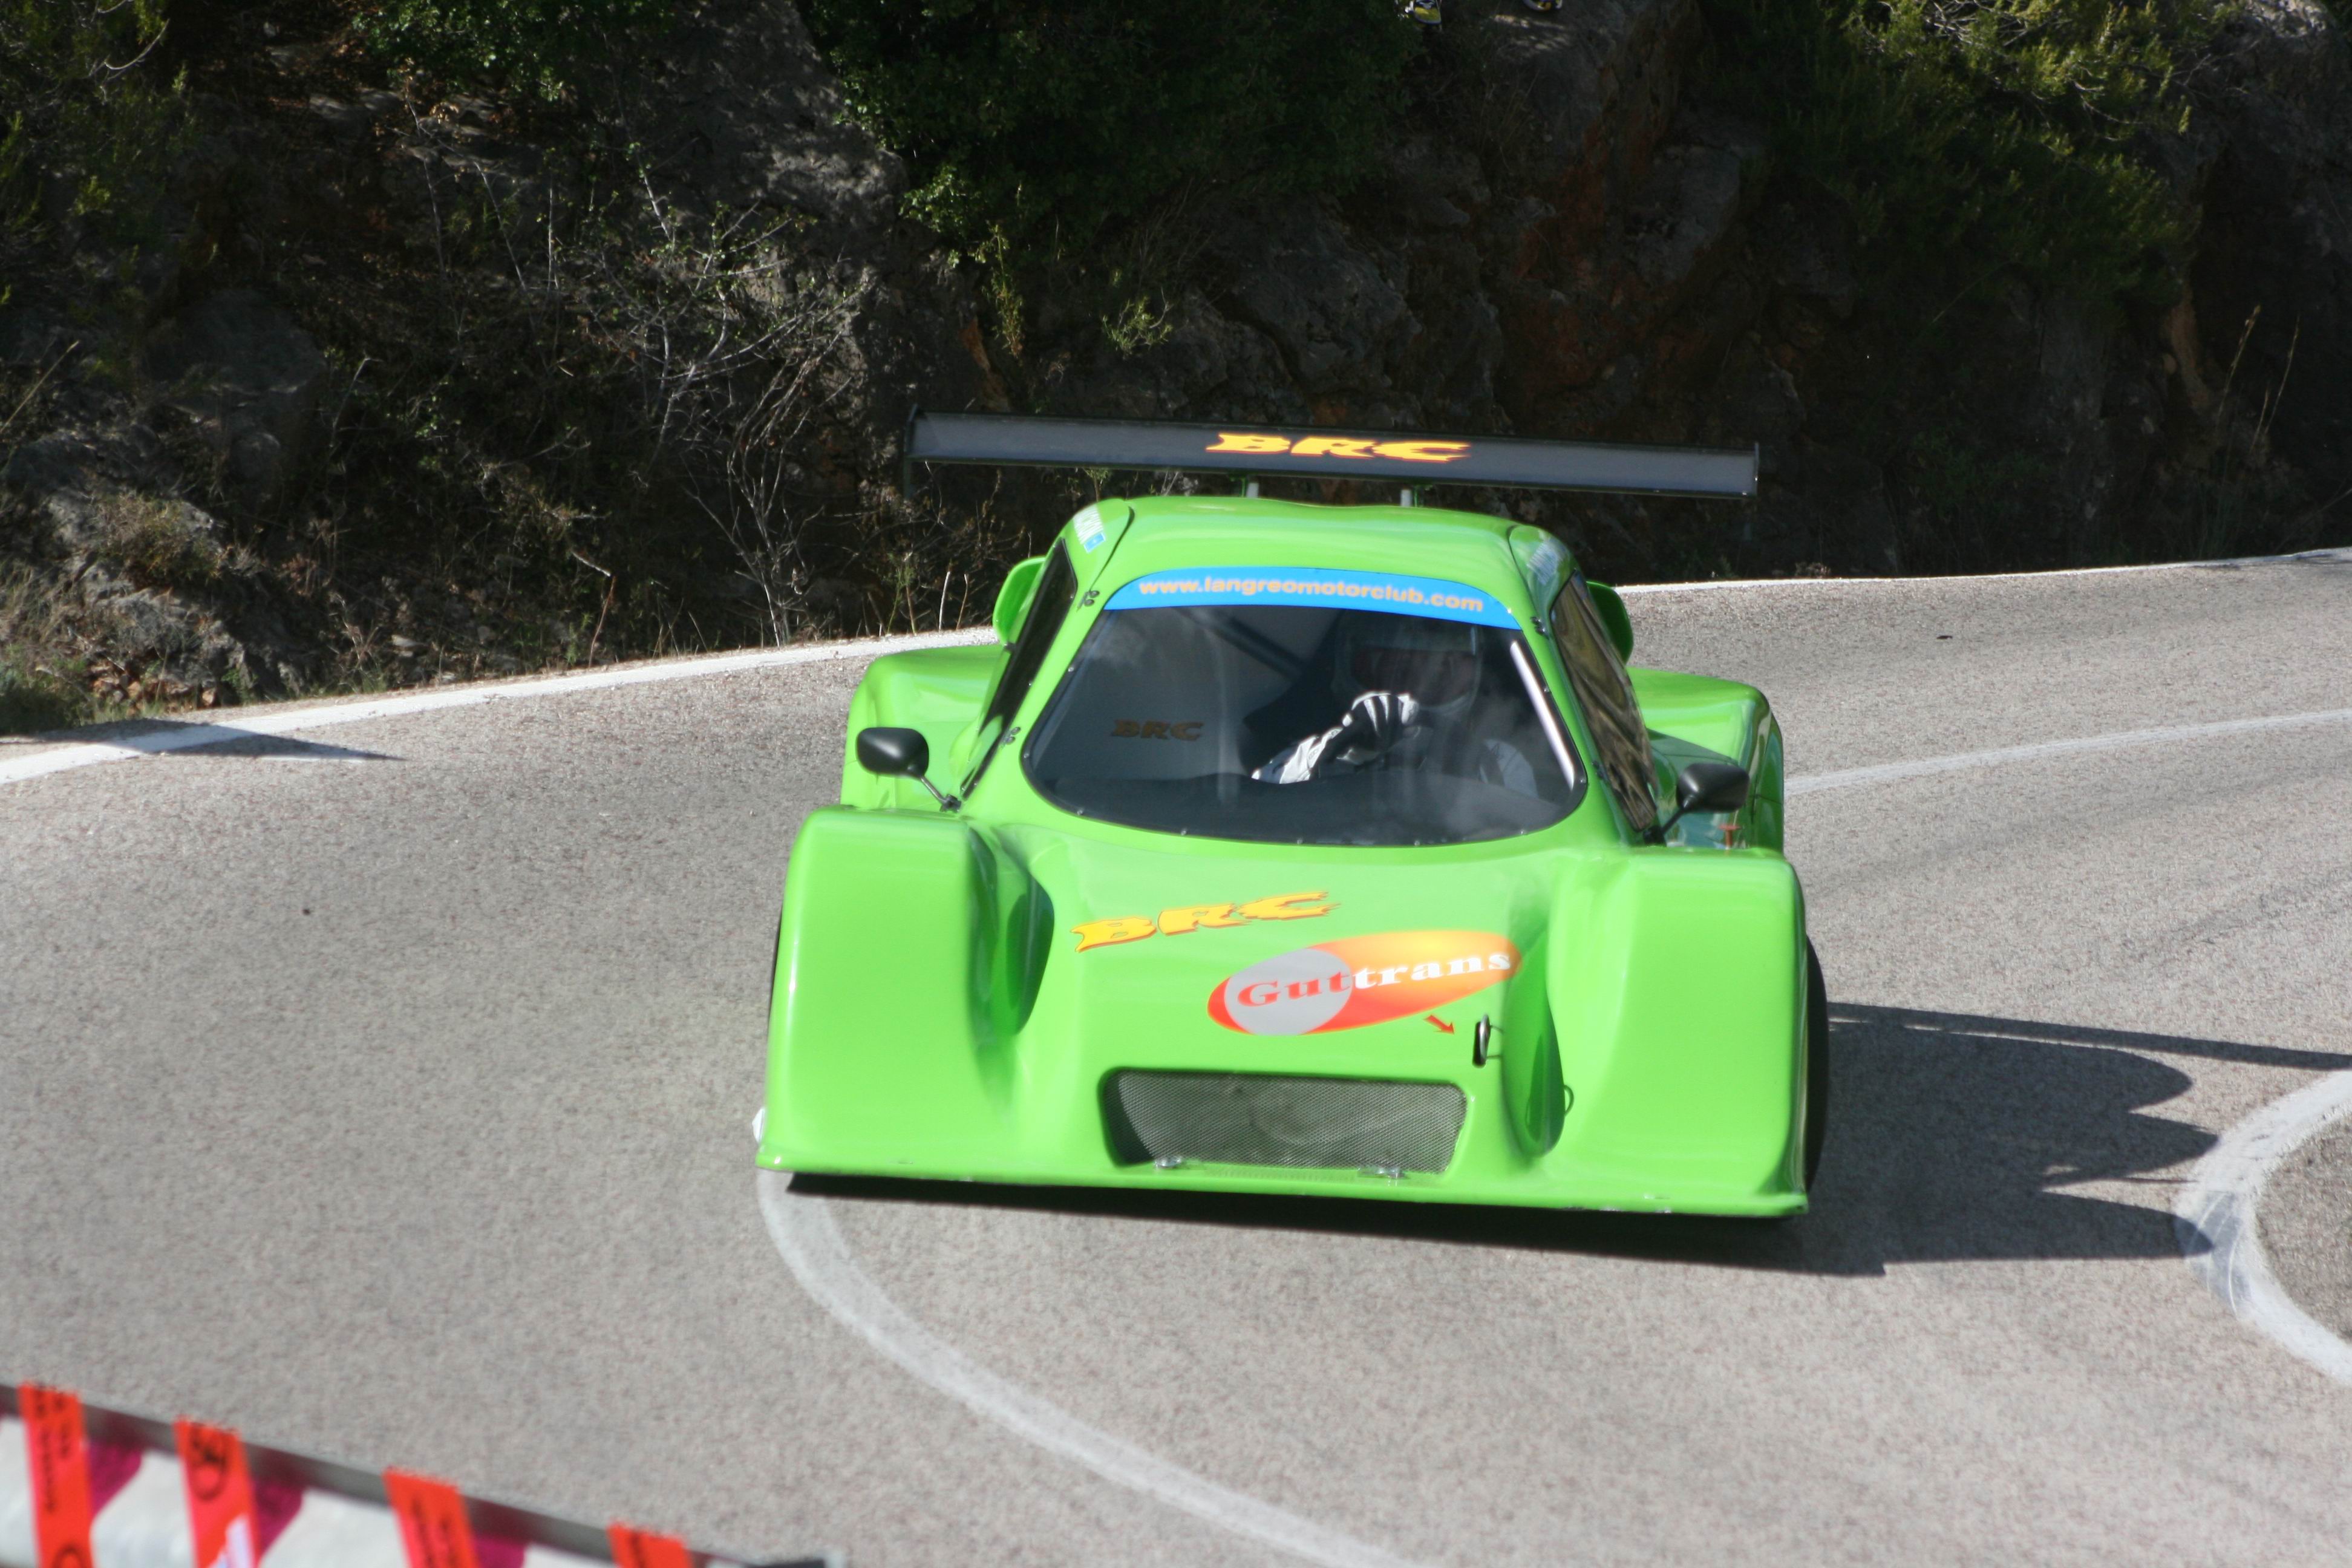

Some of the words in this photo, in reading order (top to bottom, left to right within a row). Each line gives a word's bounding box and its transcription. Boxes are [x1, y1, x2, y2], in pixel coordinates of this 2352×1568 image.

[1206, 433, 1471, 463] BRC
[1139, 576, 1483, 612] www.langreomotorclub.com
[1111, 719, 1204, 741] BRC
[1071, 891, 1341, 953] BRC
[1237, 952, 1511, 1007] Guttrans
